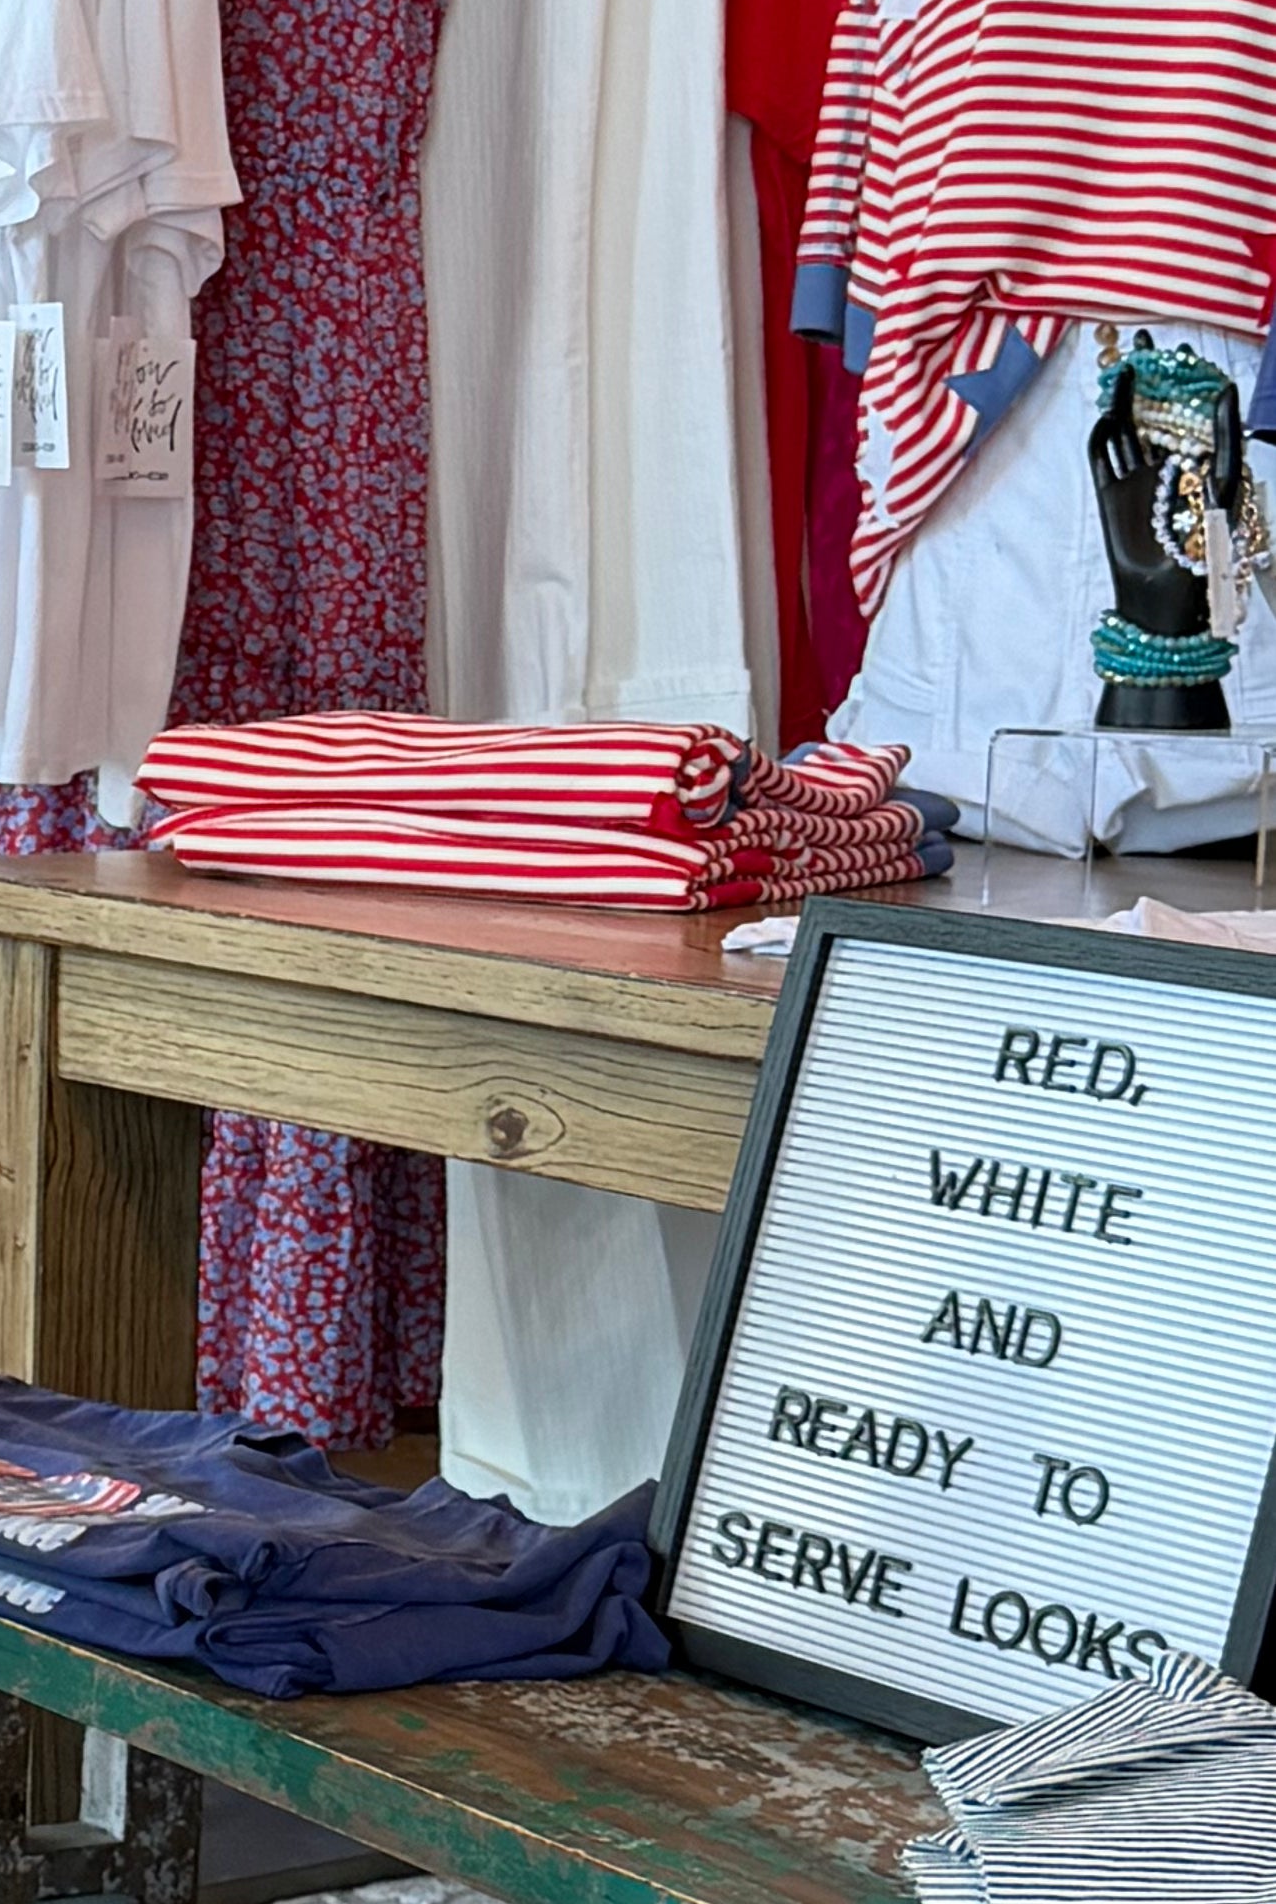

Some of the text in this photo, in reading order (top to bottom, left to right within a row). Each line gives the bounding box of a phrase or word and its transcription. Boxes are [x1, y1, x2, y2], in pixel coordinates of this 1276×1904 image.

[995, 1024, 1149, 1107] RED,
[928, 1149, 1144, 1246] WHITE
[921, 1289, 1062, 1369] AND
[768, 1385, 1111, 1526] READY TO
[711, 1511, 914, 1619] SERVE
